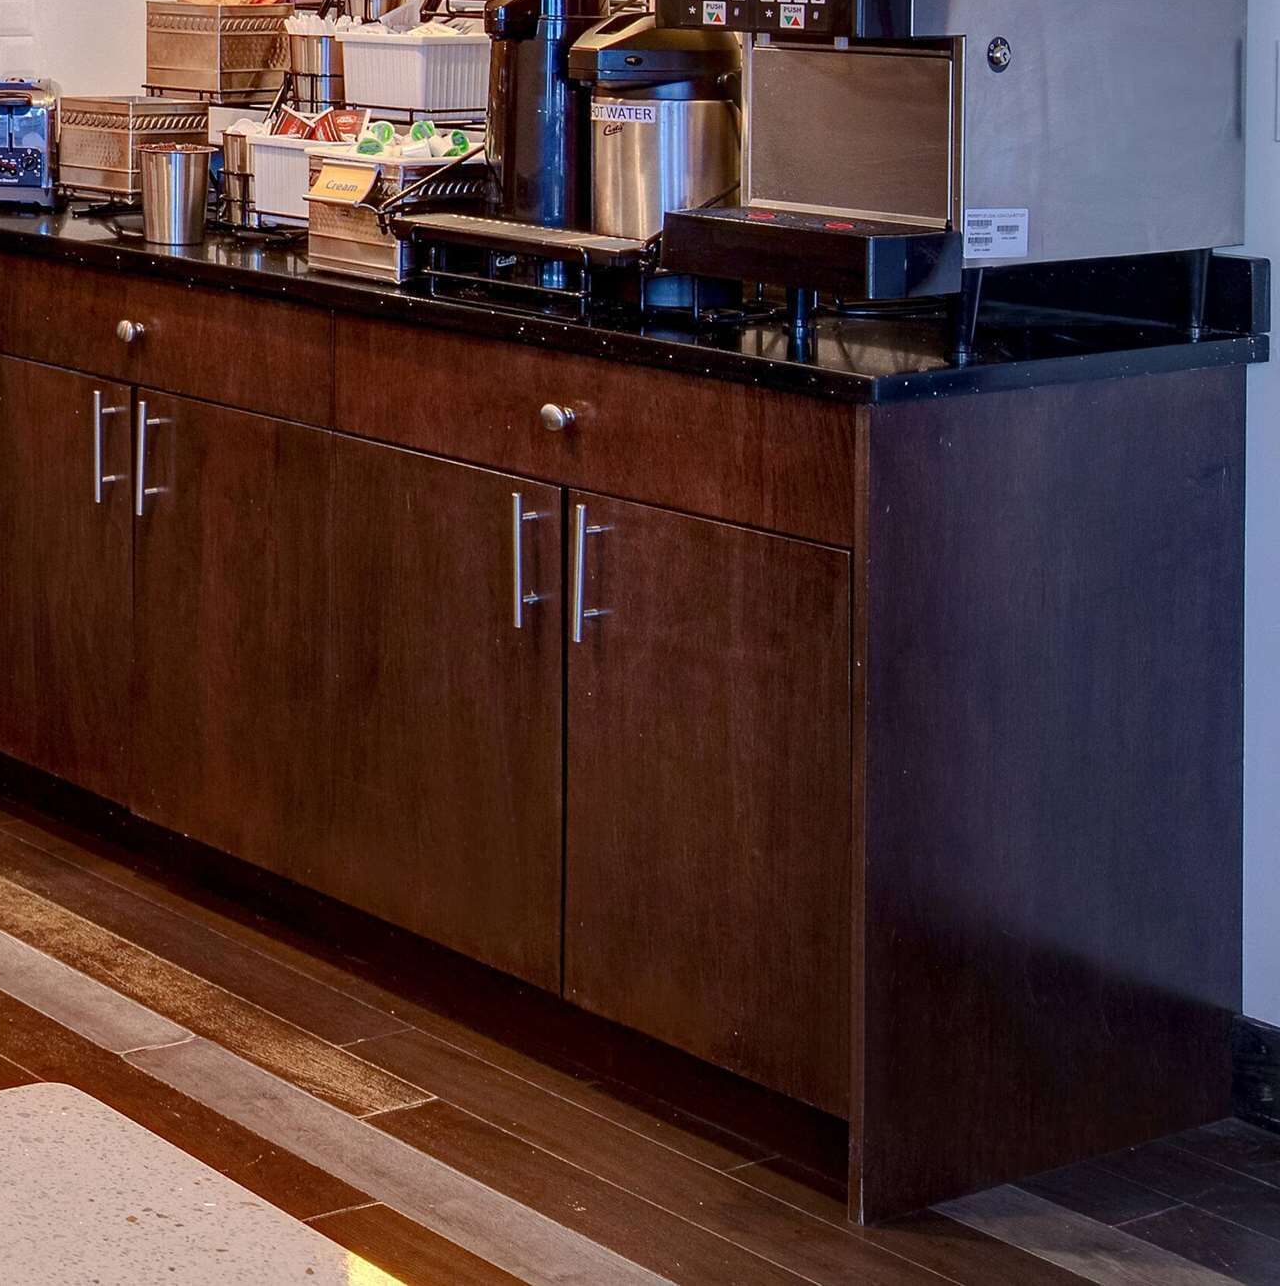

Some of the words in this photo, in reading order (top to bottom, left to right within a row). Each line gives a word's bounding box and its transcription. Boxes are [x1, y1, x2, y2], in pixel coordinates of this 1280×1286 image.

[783, 6, 802, 14] PUSH
[606, 106, 652, 120] WATER
[326, 180, 358, 191] Cream
